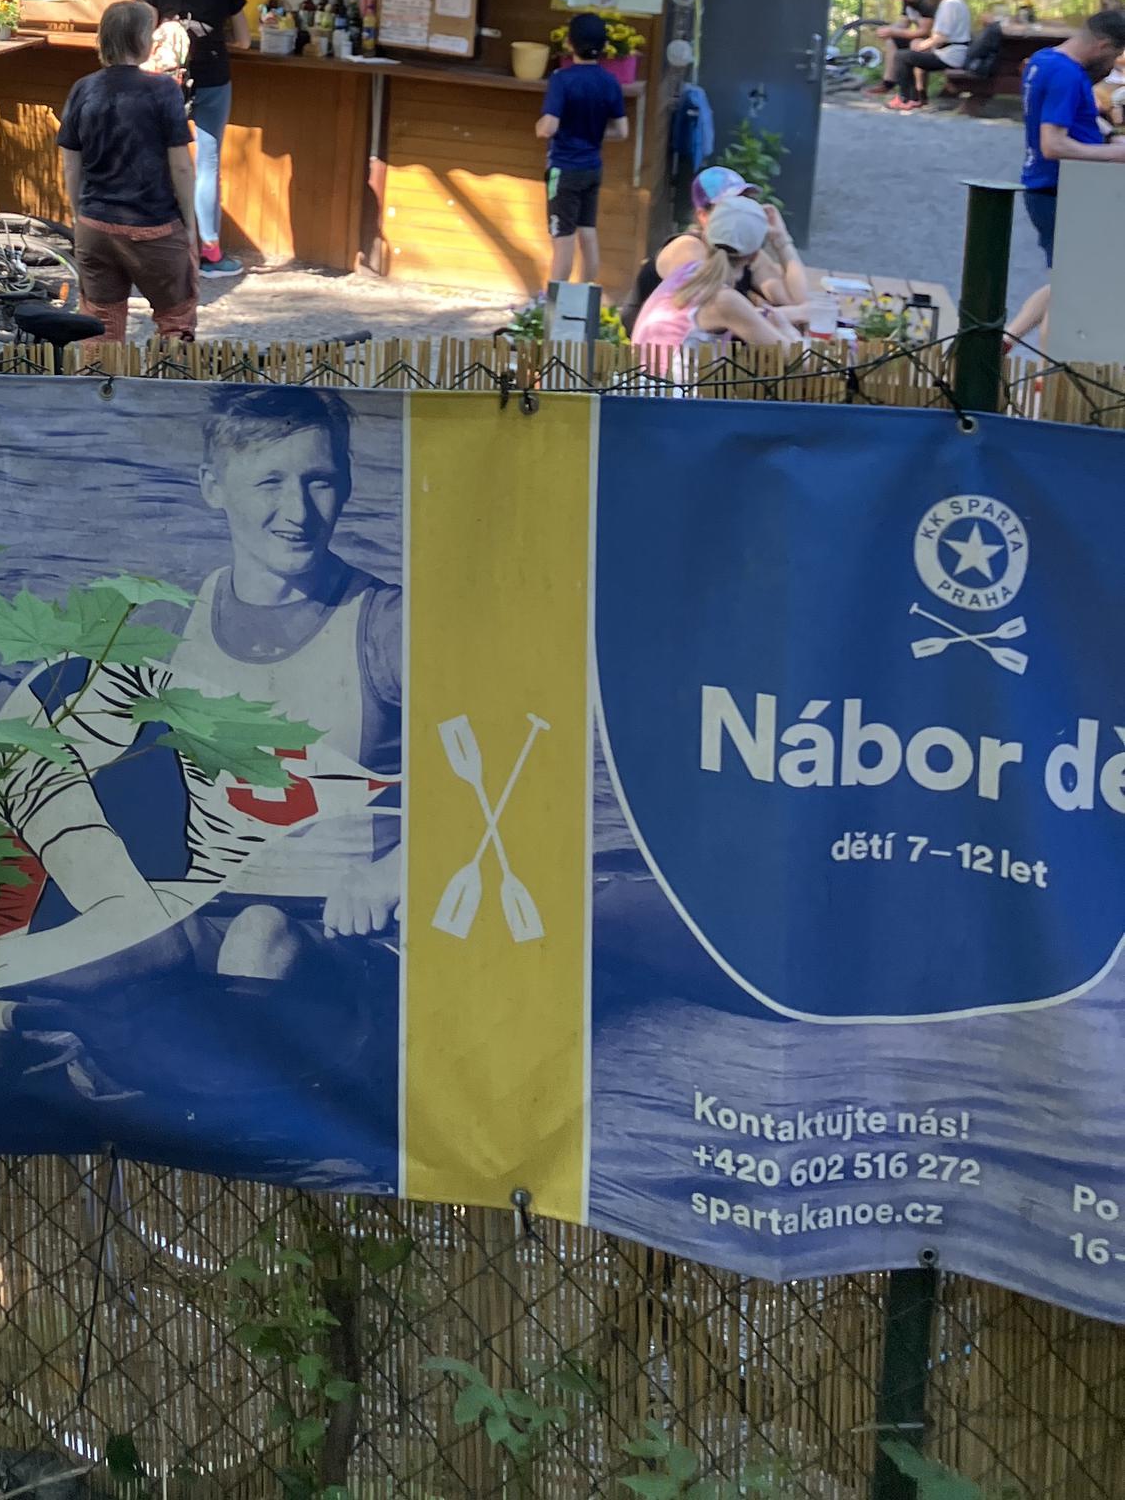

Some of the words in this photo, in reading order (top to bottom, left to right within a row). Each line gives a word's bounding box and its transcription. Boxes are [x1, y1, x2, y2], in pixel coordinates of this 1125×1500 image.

[921, 512, 946, 540] KK
[949, 498, 1025, 553] SPARTA
[936, 579, 1013, 608] PRAHA
[699, 684, 1023, 802] Nábor
[831, 831, 896, 862] dětí
[1000, 853, 1049, 889] let
[694, 1091, 887, 1143] Kontaktujte
[897, 1108, 970, 1140] nás!
[692, 1145, 780, 1187] +420
[789, 1153, 845, 1187] 602
[853, 1151, 908, 1180] 516
[916, 1155, 982, 1186] 272
[691, 1192, 944, 1236] spartakanoe.cz
[1073, 1183, 1119, 1221] Po
